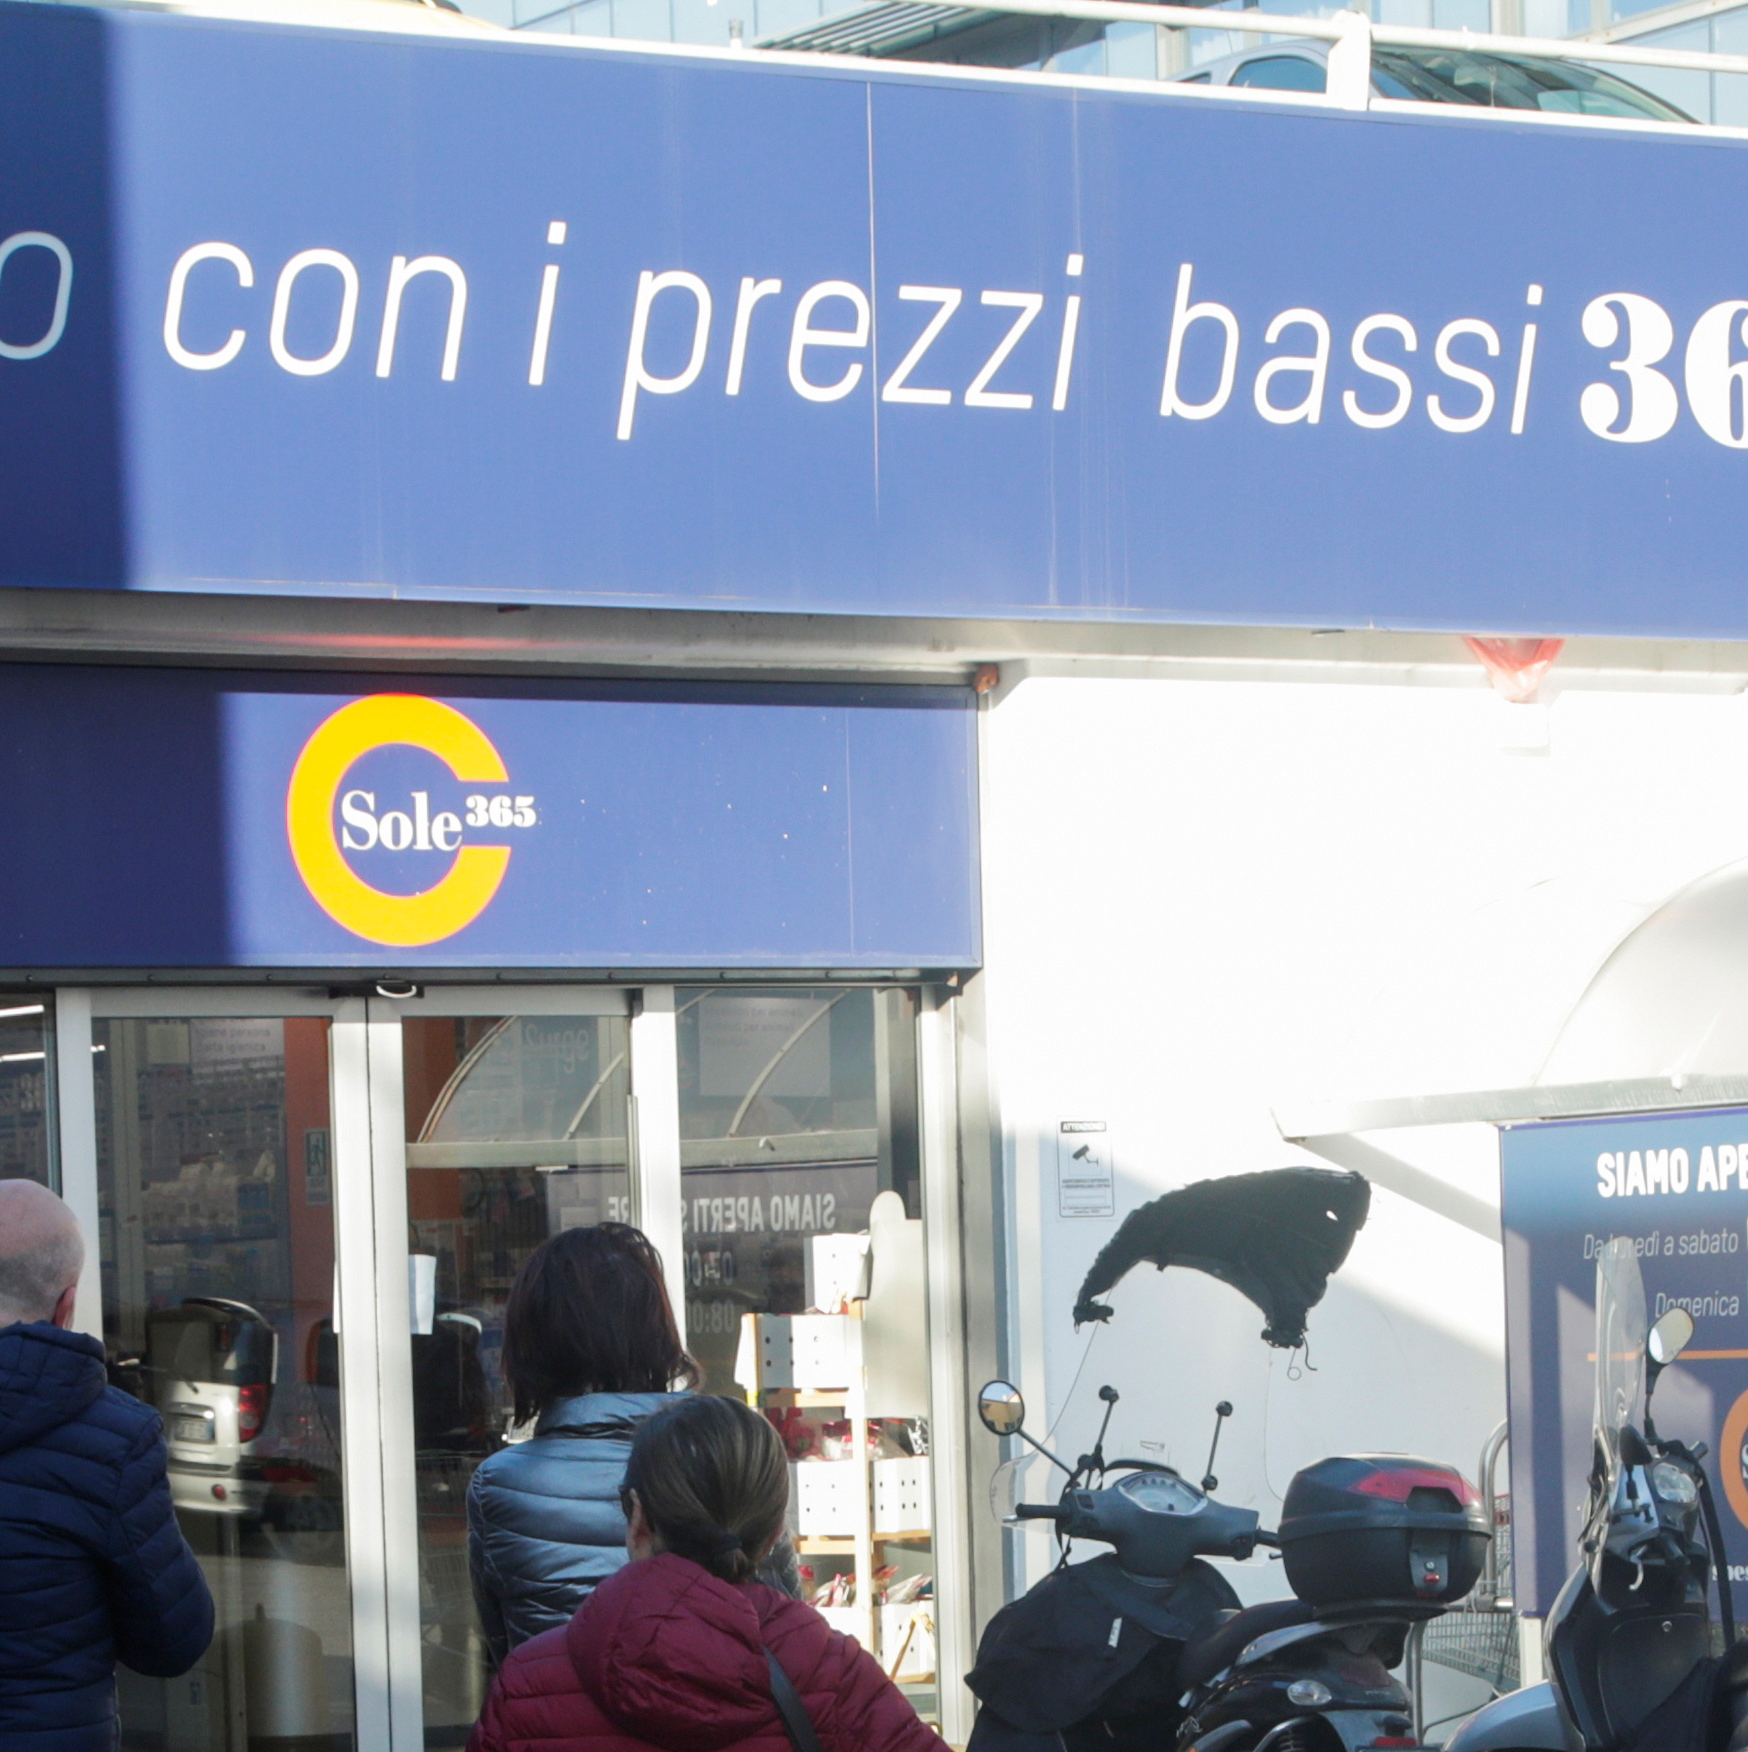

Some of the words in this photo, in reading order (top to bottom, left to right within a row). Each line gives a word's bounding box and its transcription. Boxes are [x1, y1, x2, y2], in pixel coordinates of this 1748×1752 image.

[160, 240, 468, 382] con
[527, 220, 568, 386] i
[615, 253, 1085, 441] prezzi
[1159, 262, 1543, 436] bassi
[1596, 1147, 1690, 1198] SIAMO
[1584, 1234, 1603, 1259] Da
[1663, 1236, 1673, 1256] a
[1679, 1229, 1739, 1255] sabato
[1656, 1290, 1739, 1318] Domenica
